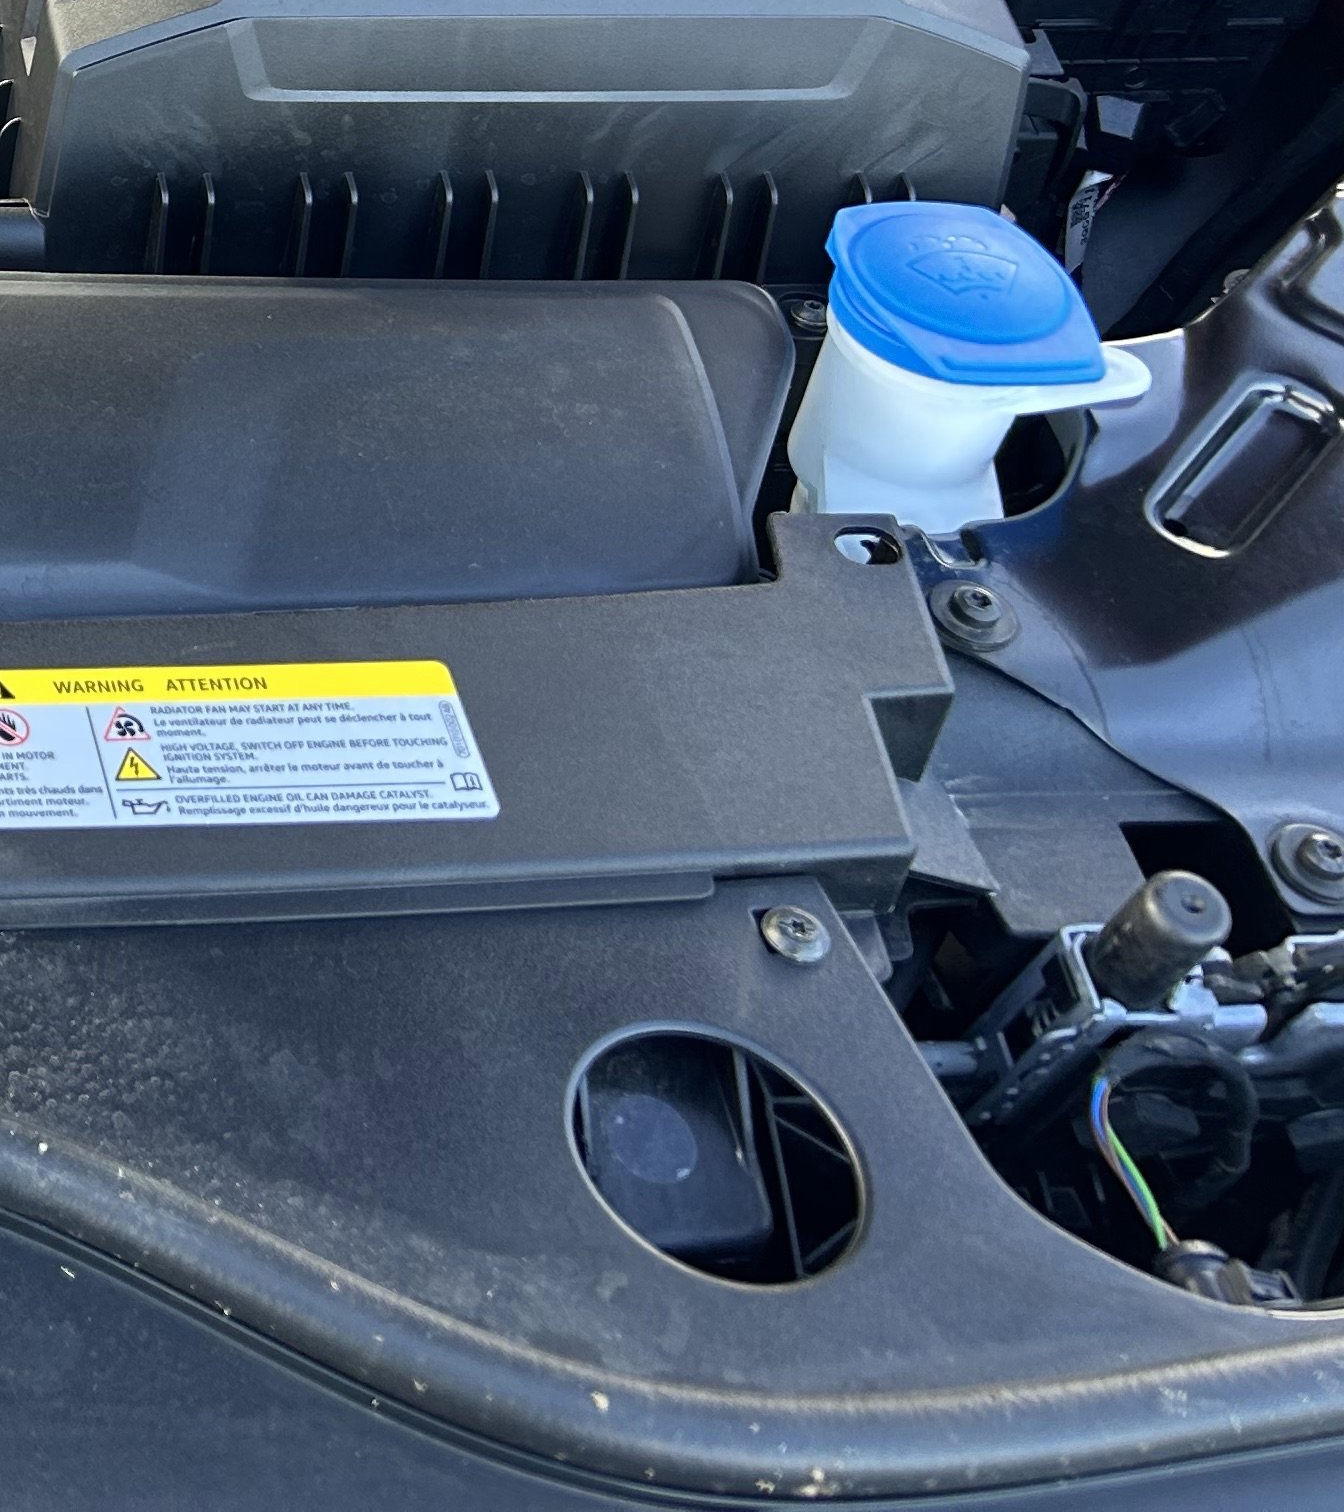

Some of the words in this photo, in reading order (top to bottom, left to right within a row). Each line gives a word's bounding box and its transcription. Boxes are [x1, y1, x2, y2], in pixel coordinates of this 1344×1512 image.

[53, 679, 144, 694] WARNING
[166, 677, 268, 691] ATTENTION
[150, 706, 201, 714] RADIATOR
[229, 705, 250, 713] MAY
[303, 703, 323, 711] ANY
[169, 718, 227, 726] ventilateur
[298, 717, 322, 726] peut
[340, 713, 397, 722] déclencher
[160, 743, 187, 751] HIGH
[241, 742, 281, 750] SWITCH
[284, 741, 304, 749] OFF
[307, 740, 346, 748] ENGINE
[349, 739, 390, 747] BEFORE
[393, 738, 448, 746] TOUCHING
[164, 753, 211, 761] IGNITION
[214, 752, 256, 760] SYSTEM.
[167, 765, 200, 773] Haute
[288, 763, 297, 771] le
[301, 763, 340, 771] moteur
[344, 762, 374, 770] avant
[377, 761, 390, 769] de
[392, 760, 433, 768] toucher
[16, 786, 36, 794] très
[39, 786, 75, 794] chauds
[78, 785, 103, 793] dans
[46, 798, 89, 806] moteur.
[175, 795, 240, 804] OVERFILLED
[244, 794, 283, 802] ENGINE
[286, 793, 304, 801] OIL
[332, 791, 376, 800] DAMAGE
[9, 809, 78, 817] mouvement.
[179, 806, 246, 816] Remplissage
[249, 802, 291, 814] excessif
[333, 803, 389, 813] dangereux
[392, 802, 416, 812] pour
[420, 801, 428, 809] le
[432, 801, 488, 811] catalyseur.
